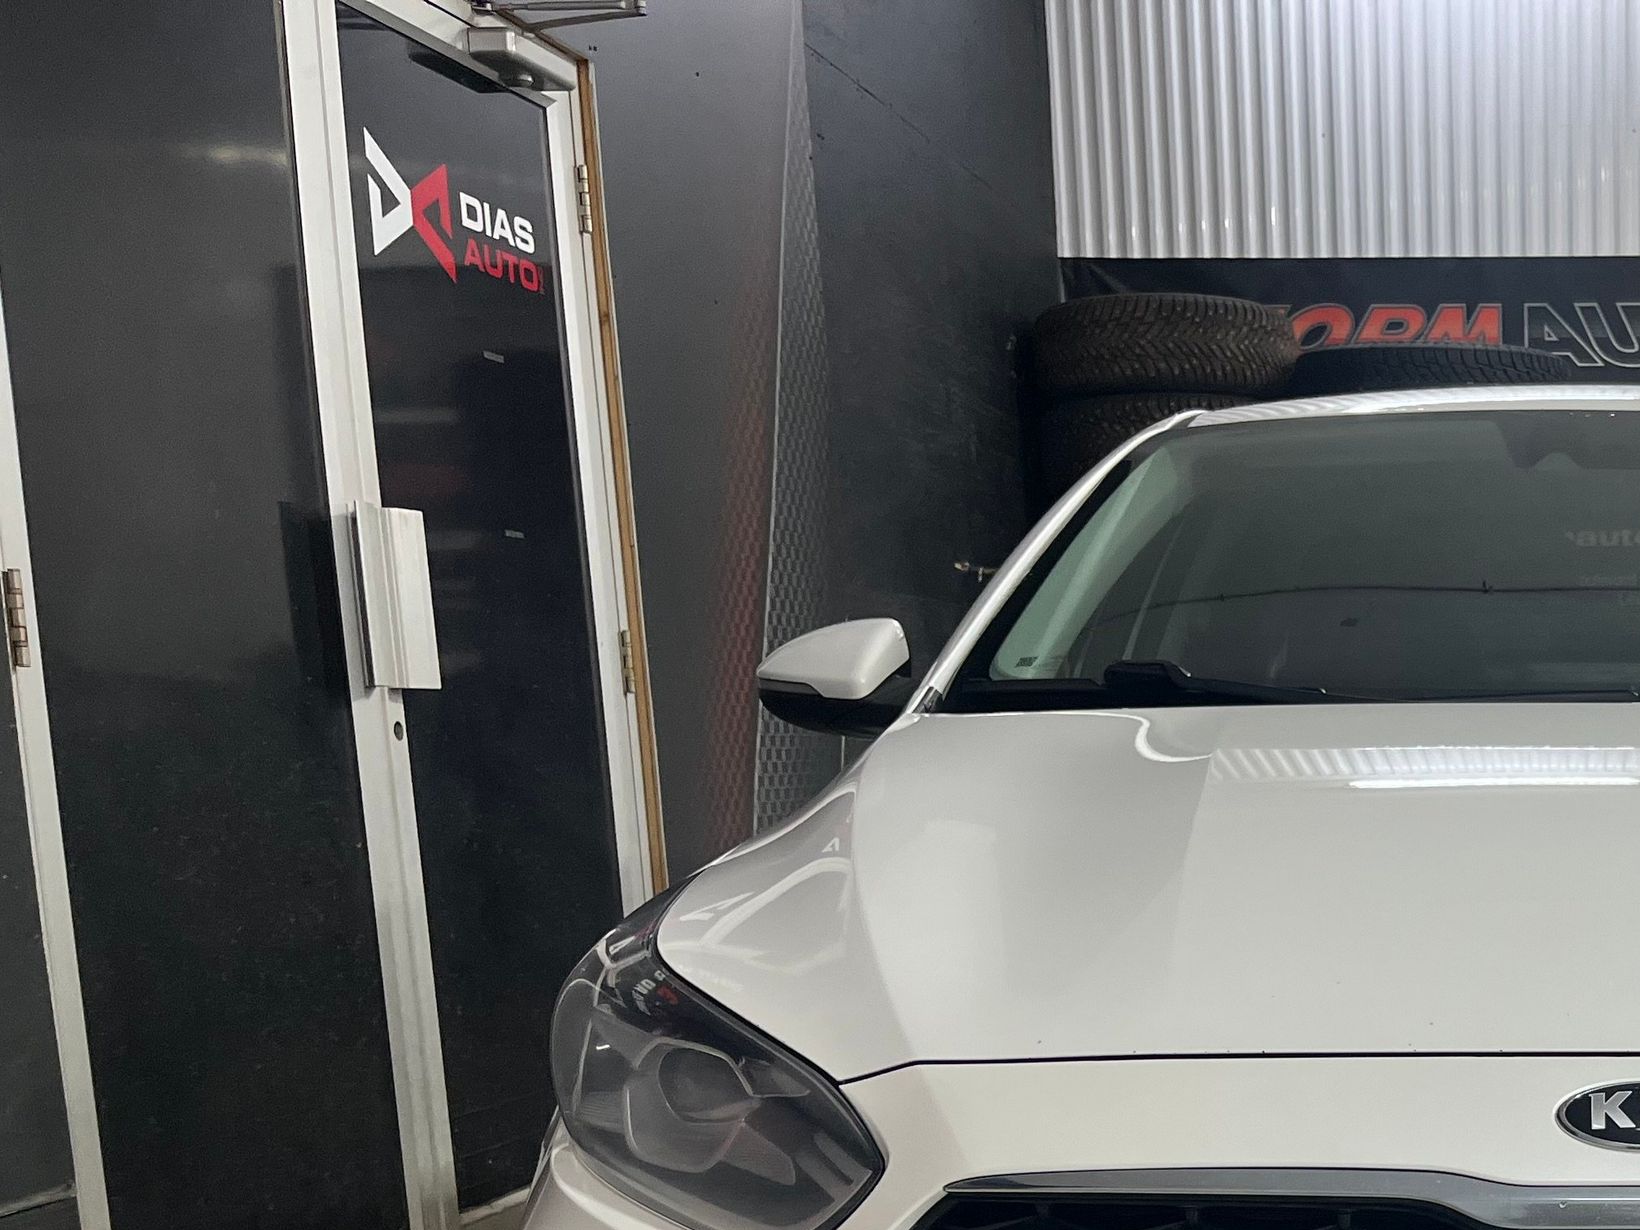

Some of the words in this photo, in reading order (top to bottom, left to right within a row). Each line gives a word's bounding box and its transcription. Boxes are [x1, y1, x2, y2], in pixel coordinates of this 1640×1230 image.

[460, 191, 535, 254] DIAS
[464, 238, 539, 292] AUTO
[1264, 302, 1503, 350] ORM
